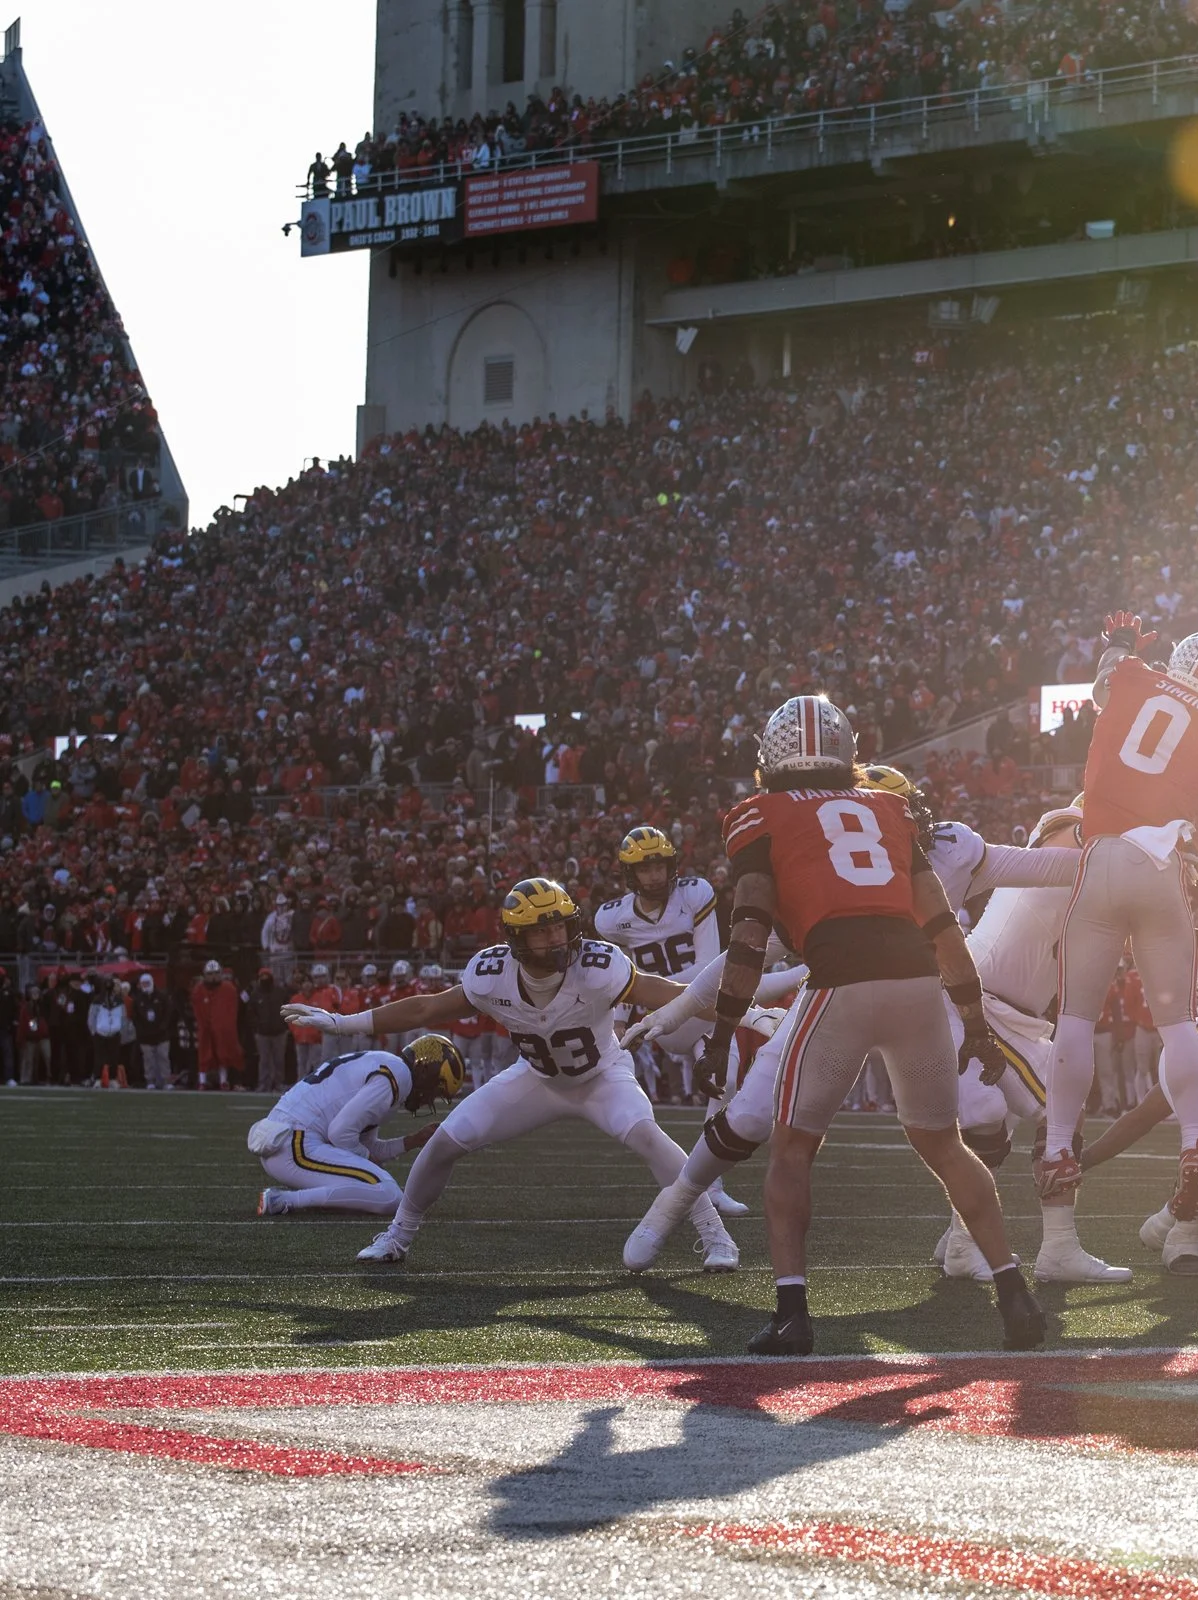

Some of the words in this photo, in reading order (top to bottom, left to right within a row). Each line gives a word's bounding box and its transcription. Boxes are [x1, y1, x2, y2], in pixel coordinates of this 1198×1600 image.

[331, 197, 380, 233] PAUL
[384, 187, 457, 227] BROWN
[1119, 695, 1191, 774] 0
[816, 800, 895, 886] 8
[634, 931, 696, 977] 96
[510, 1026, 601, 1077] 83
